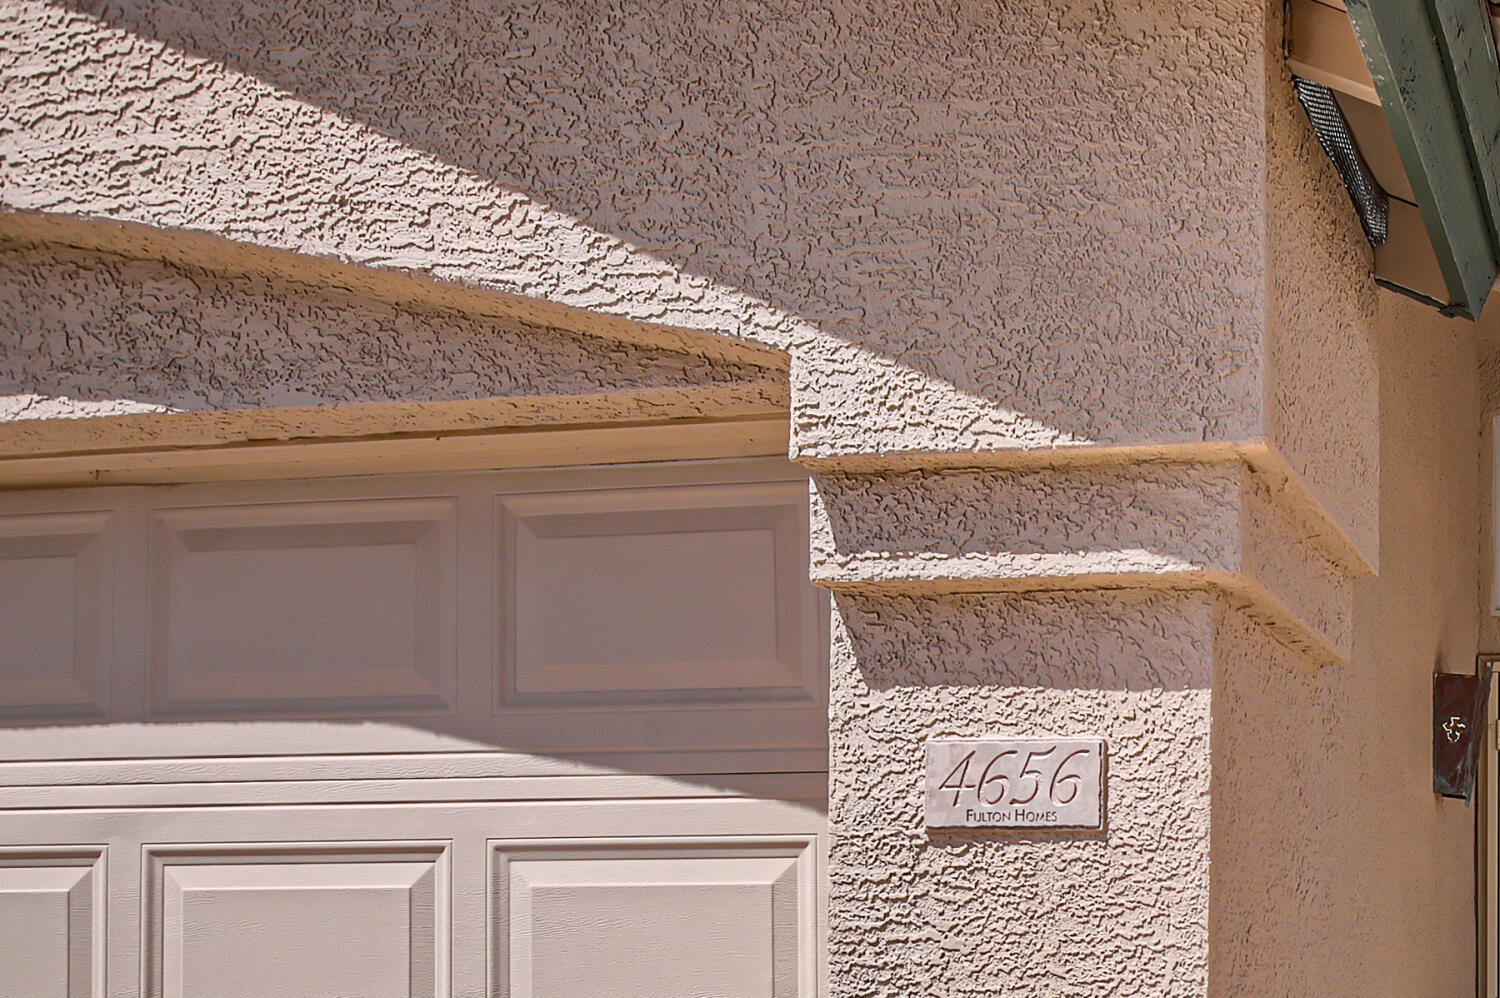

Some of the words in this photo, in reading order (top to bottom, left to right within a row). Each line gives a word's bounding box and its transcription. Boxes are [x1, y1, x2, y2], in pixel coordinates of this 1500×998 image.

[938, 745, 1090, 807] 4656
[966, 809, 1011, 823] FULTON
[1014, 809, 1058, 823] HOMES
